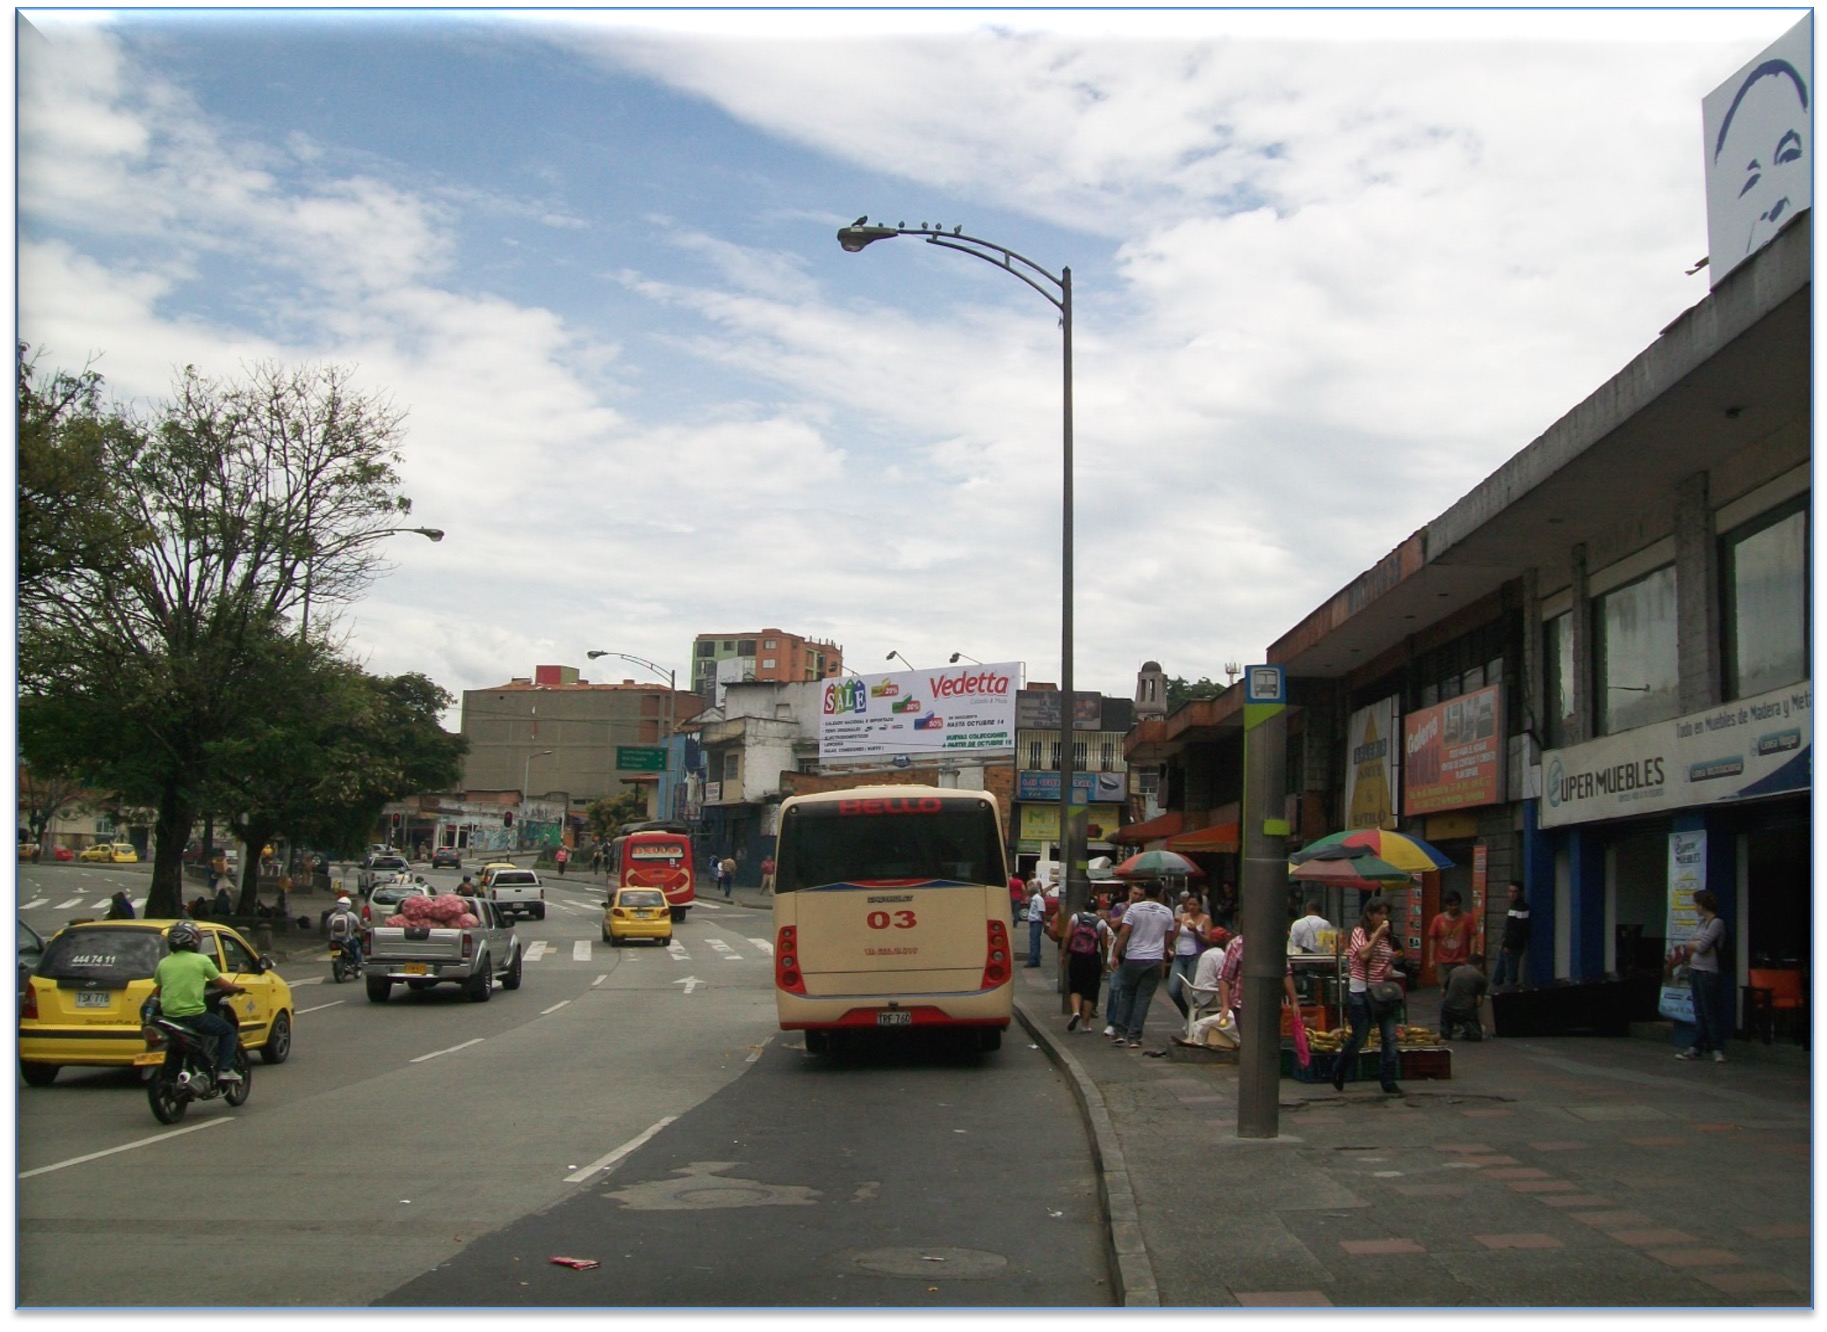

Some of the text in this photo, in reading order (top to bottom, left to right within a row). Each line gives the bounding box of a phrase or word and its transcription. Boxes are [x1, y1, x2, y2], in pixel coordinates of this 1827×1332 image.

[930, 671, 1009, 699] Vedetta
[825, 689, 865, 711] SALE
[967, 719, 995, 727] OCTUBRE
[1705, 711, 1736, 731] Muebles
[1738, 708, 1748, 725] de
[1750, 701, 1781, 721] Madera
[1783, 700, 1790, 719] y
[1595, 756, 1665, 797] MUEBLES
[839, 797, 942, 816] BELLO
[867, 911, 917, 930] 03
[72, 955, 117, 964] 444 74 11
